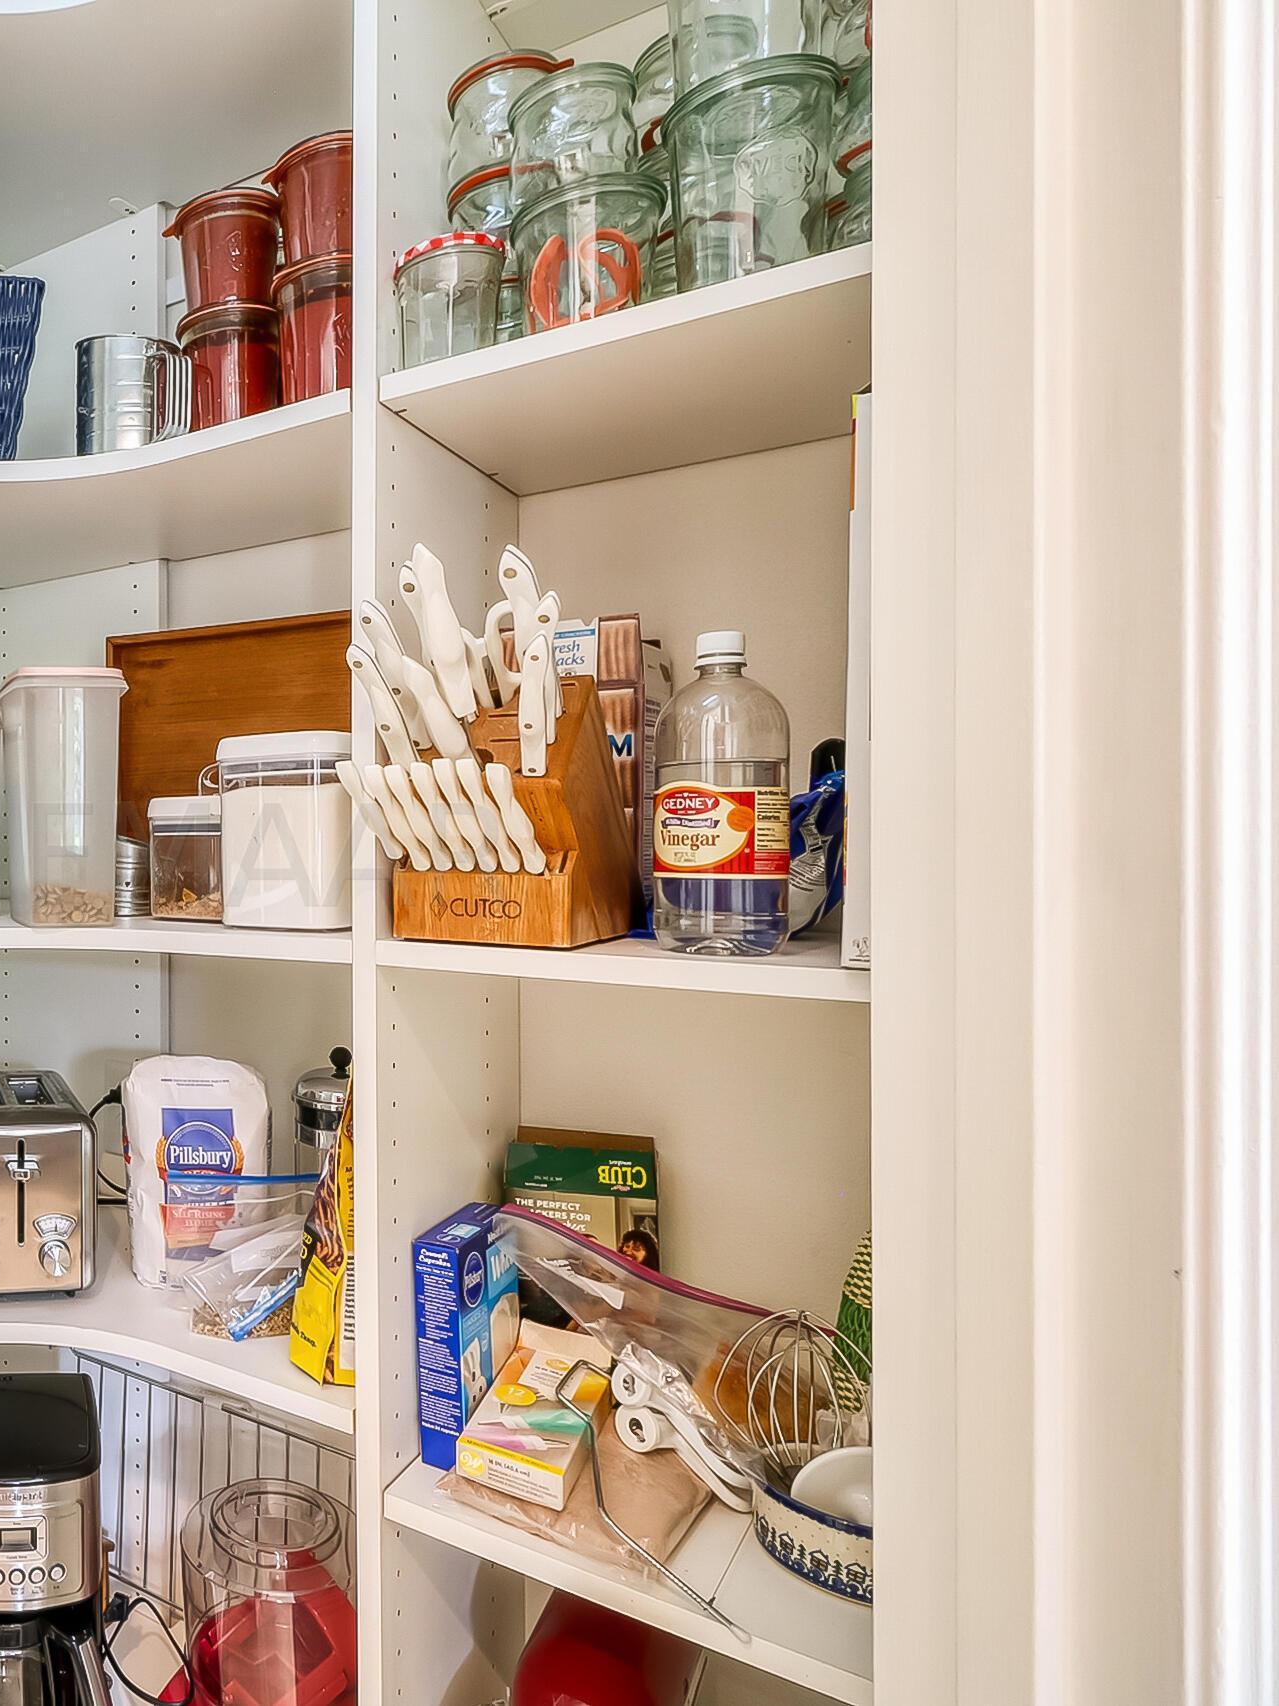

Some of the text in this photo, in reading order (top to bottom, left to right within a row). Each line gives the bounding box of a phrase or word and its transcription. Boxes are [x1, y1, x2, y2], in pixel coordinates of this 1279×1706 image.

[554, 640, 580, 653] resh
[556, 654, 586, 667] acks
[663, 797, 716, 810] GEDNEY
[660, 829, 720, 851] Vinegar
[449, 897, 522, 919] CUTCO
[170, 1145, 231, 1168] Pillsbury
[597, 1165, 647, 1189] CLUB
[515, 1197, 581, 1211] THE PERFECT
[569, 1212, 591, 1222] FOR
